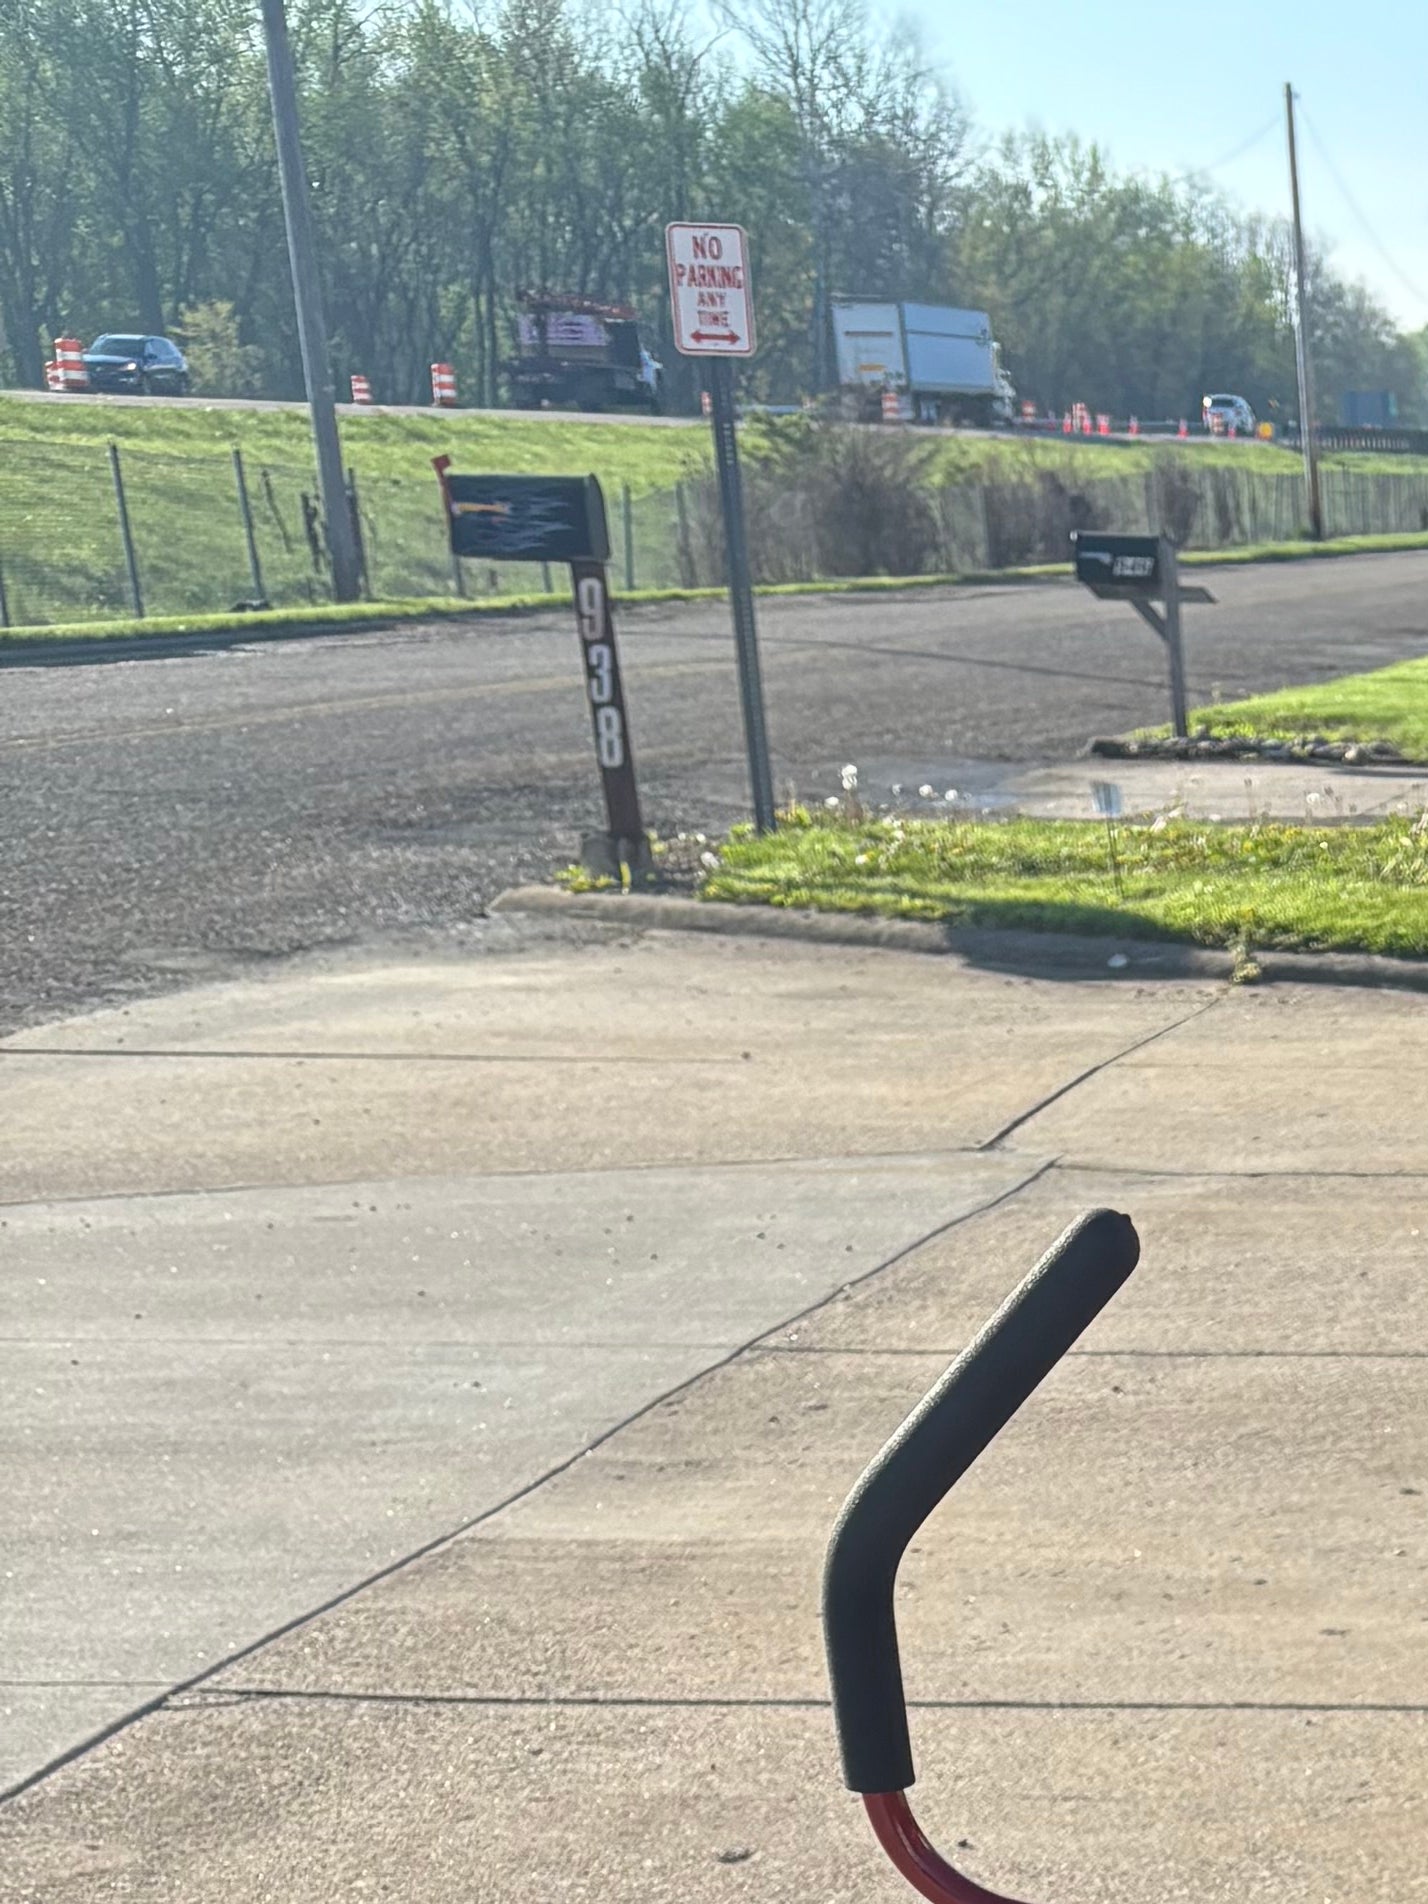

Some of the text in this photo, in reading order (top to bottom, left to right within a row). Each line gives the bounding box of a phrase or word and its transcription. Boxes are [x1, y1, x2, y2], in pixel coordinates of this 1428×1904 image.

[692, 235, 723, 260] NO
[676, 263, 743, 289] PARKING
[697, 291, 727, 307] ANY
[578, 576, 624, 769] 938
